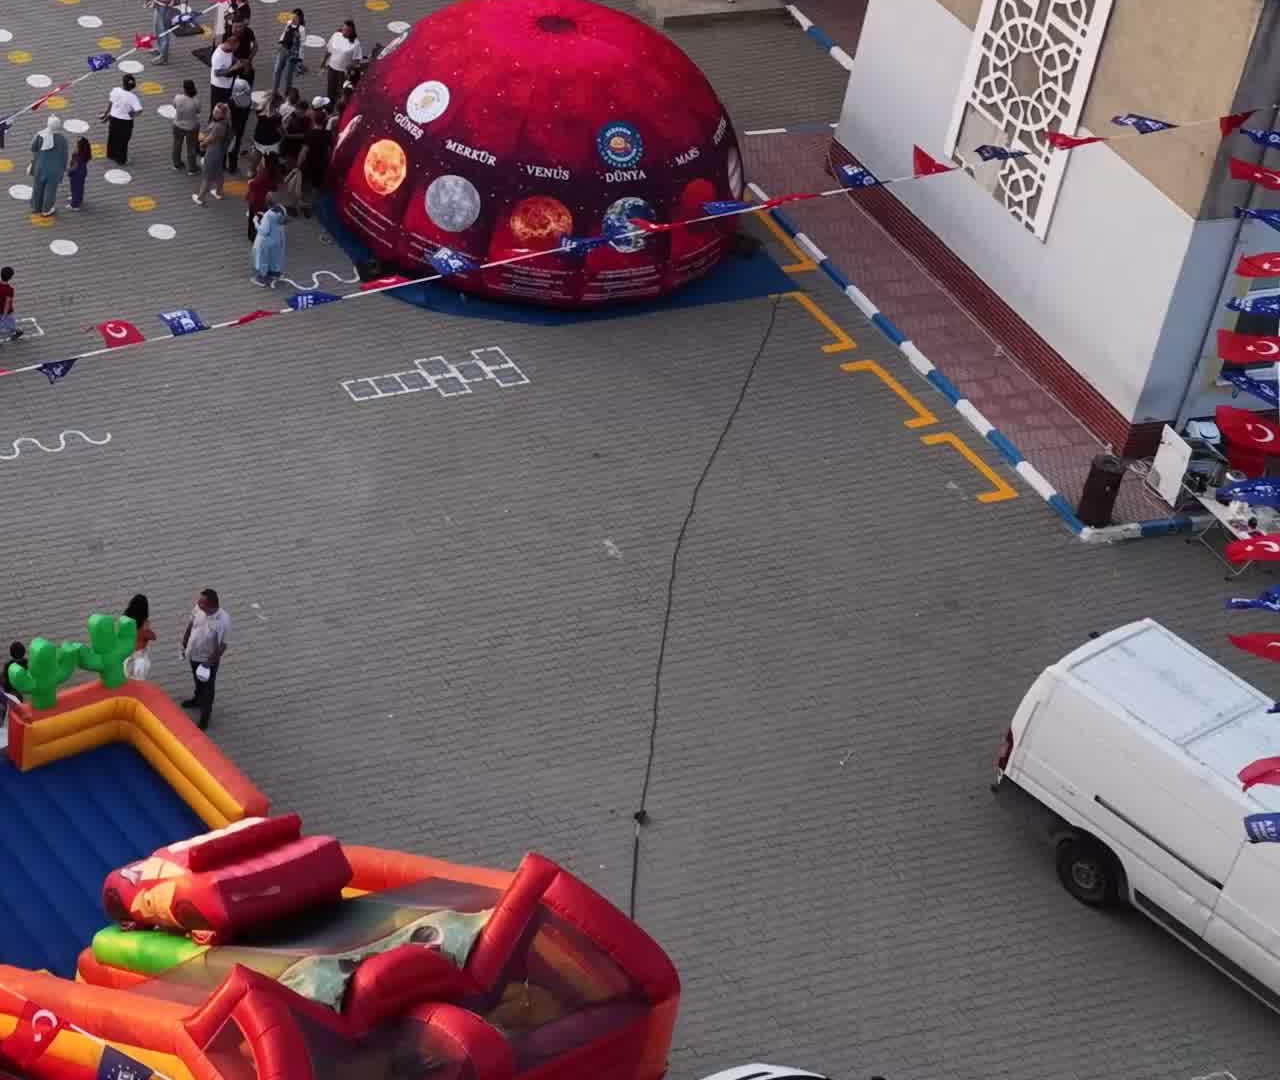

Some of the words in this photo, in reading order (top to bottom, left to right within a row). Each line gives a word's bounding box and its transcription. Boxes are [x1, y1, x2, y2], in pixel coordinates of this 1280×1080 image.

[394, 112, 425, 140] GÜNEŞ
[446, 138, 497, 168] MERKÜR
[675, 146, 701, 166] MARS
[605, 169, 647, 183] DÜNYA
